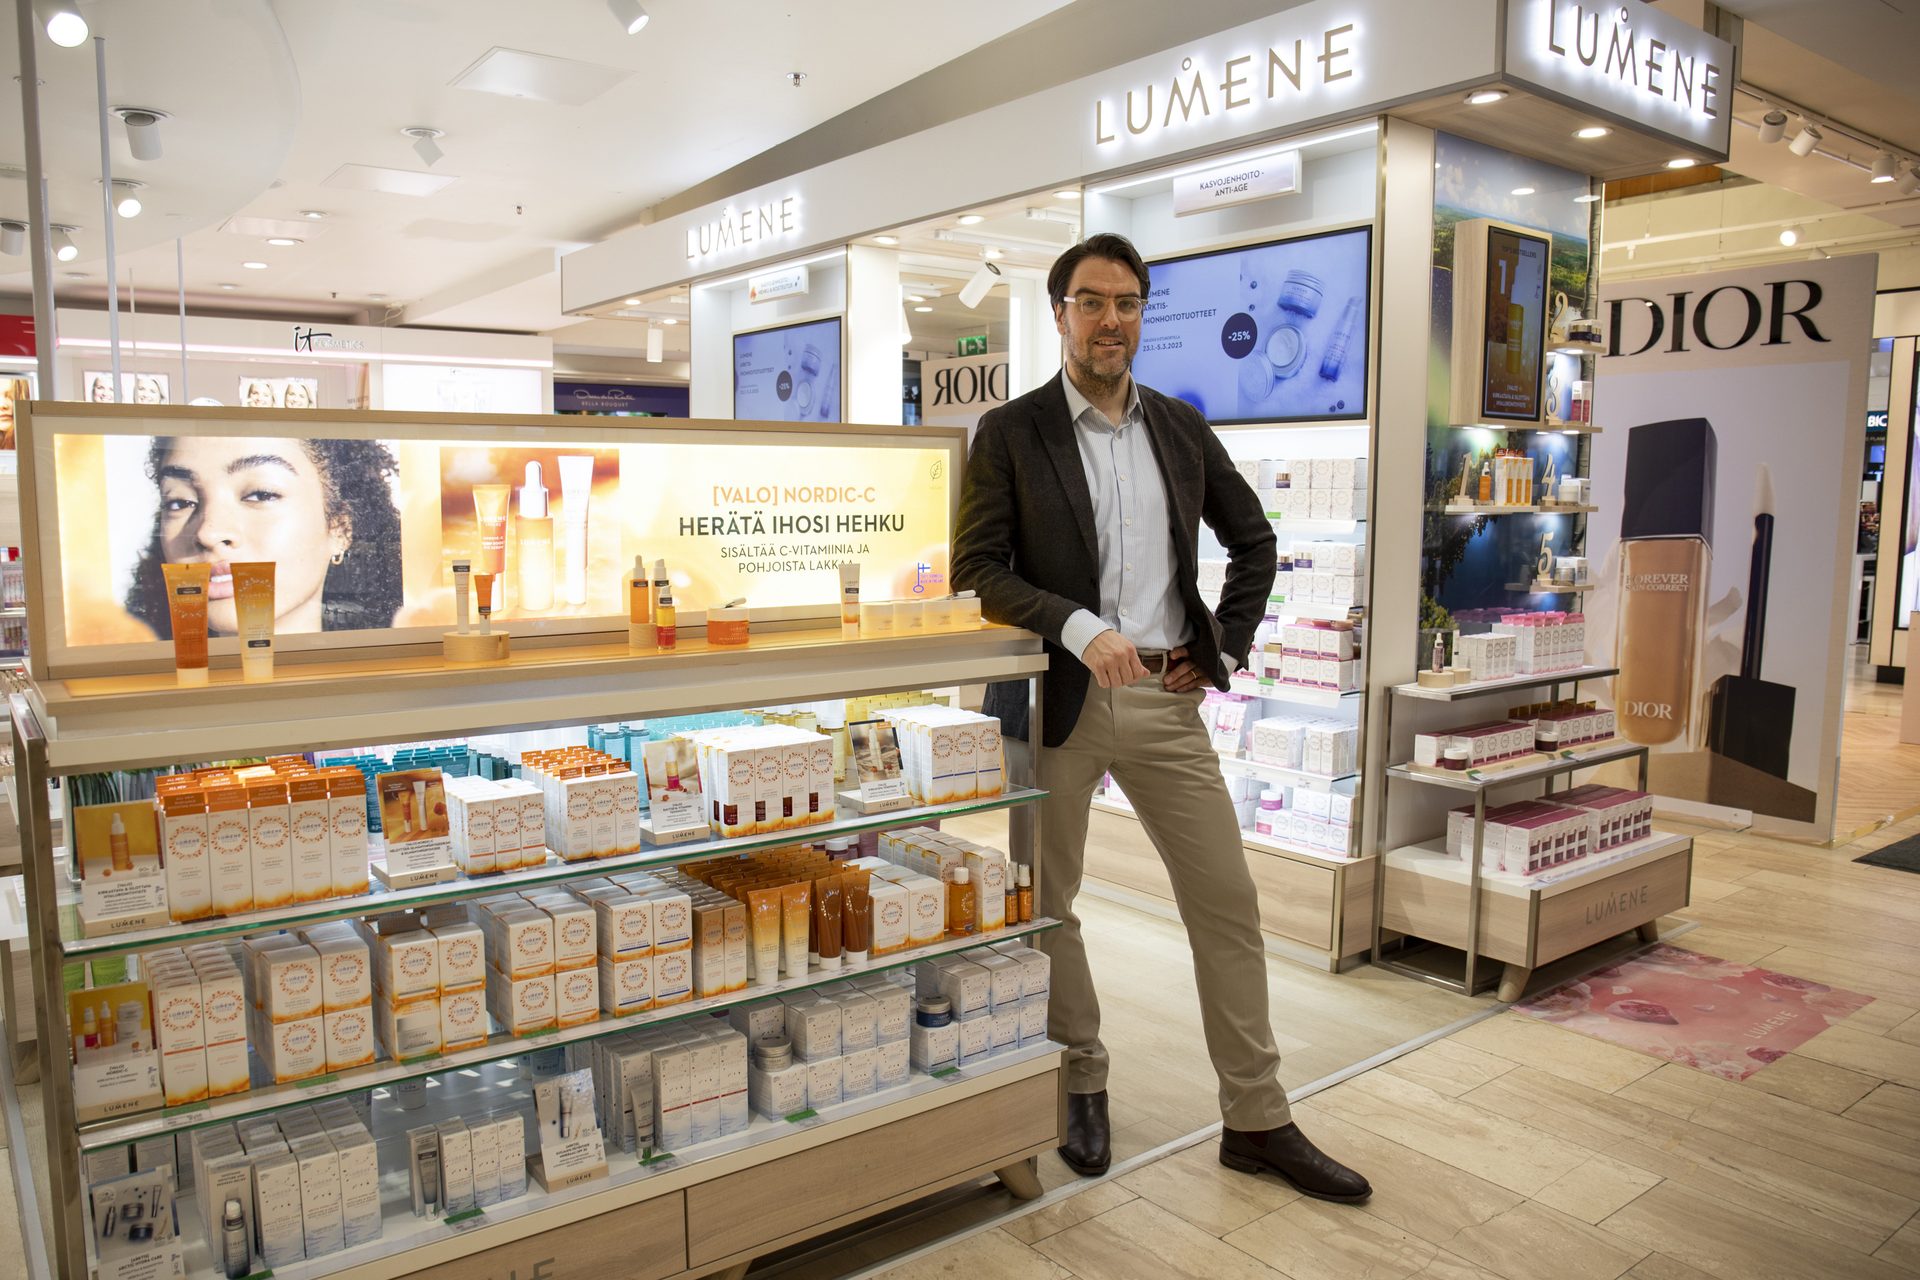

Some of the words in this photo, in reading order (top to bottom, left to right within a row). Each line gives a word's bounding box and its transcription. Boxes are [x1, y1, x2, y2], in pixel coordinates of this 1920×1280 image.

[1200, 170, 1260, 190] KASVOJENHOITO
[1215, 183, 1248, 197] ANTI-AGE
[1499, 259, 1506, 295] 1
[1143, 308, 1217, 325] IHONHOITOTUOTTEET
[1602, 280, 1831, 358] DIOR
[1228, 331, 1251, 342] -25%
[1542, 453, 1555, 497] 4
[713, 486, 778, 506] [VALO]
[784, 487, 876, 503] NORDIC-C
[679, 510, 765, 536] HERÄTÄ
[773, 514, 829, 534] IHOSI
[837, 514, 905, 532] HEHKU
[721, 543, 776, 558] SISÄLTÄÄ
[780, 544, 854, 557] C-VITAMIINIA
[857, 544, 870, 554] JA
[1538, 531, 1554, 578] 5
[739, 560, 806, 574] POHJOISTA
[1626, 573, 1688, 584] FOREVER
[1647, 584, 1689, 592] CORRECT
[1624, 702, 1672, 720] DIOR
[1586, 884, 1649, 925] LUMENE
[1744, 1009, 1798, 1040] LUMENE
